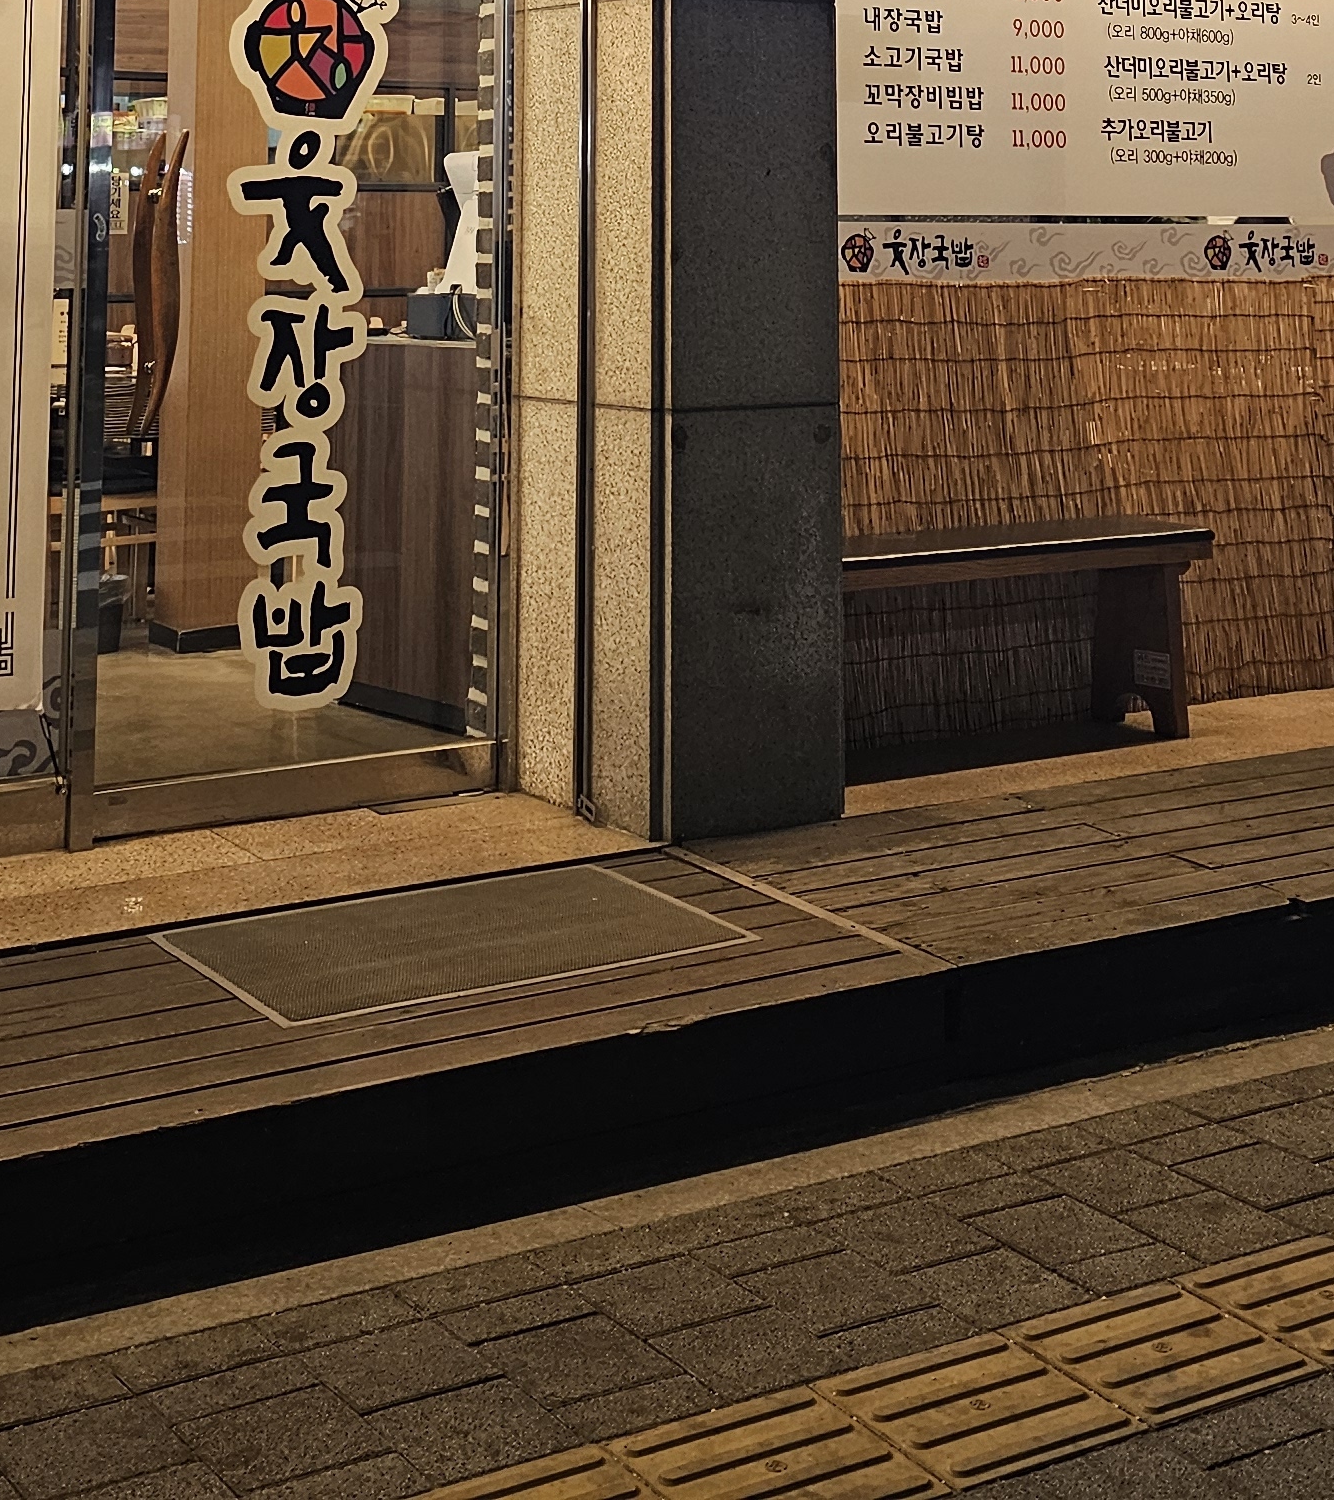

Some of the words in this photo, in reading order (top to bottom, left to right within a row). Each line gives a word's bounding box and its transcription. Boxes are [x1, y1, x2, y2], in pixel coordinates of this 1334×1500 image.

[862, 6, 944, 35] 내장국밥
[1012, 18, 1065, 40] 9,000
[1107, 22, 1136, 41] (오리
[1139, 27, 1234, 46] 800g+야채600g)
[1290, 13, 1321, 28] 3~4인
[862, 45, 964, 73] 소고기국밥
[1010, 55, 1066, 76] 11,000
[1103, 54, 1288, 86] 산더미오리불고기+오리탕
[1306, 73, 1322, 86] 2인
[862, 83, 985, 111] 꼬막장비빔밥
[1010, 92, 1066, 113] 11,000
[1108, 85, 1137, 103] (오리
[1141, 87, 1237, 106] 500g+야채350g)
[862, 121, 985, 149] 오리불고기탕
[1011, 129, 1067, 150] 11,000
[1100, 117, 1213, 144] 추가오리불고기
[1110, 146, 1139, 165] (오리
[1143, 149, 1238, 167] 300g+야채200g)
[882, 228, 974, 276] 웃장국밥
[1238, 230, 1316, 273] 웃장국밥
[239, 130, 357, 697] 웃장국밥
